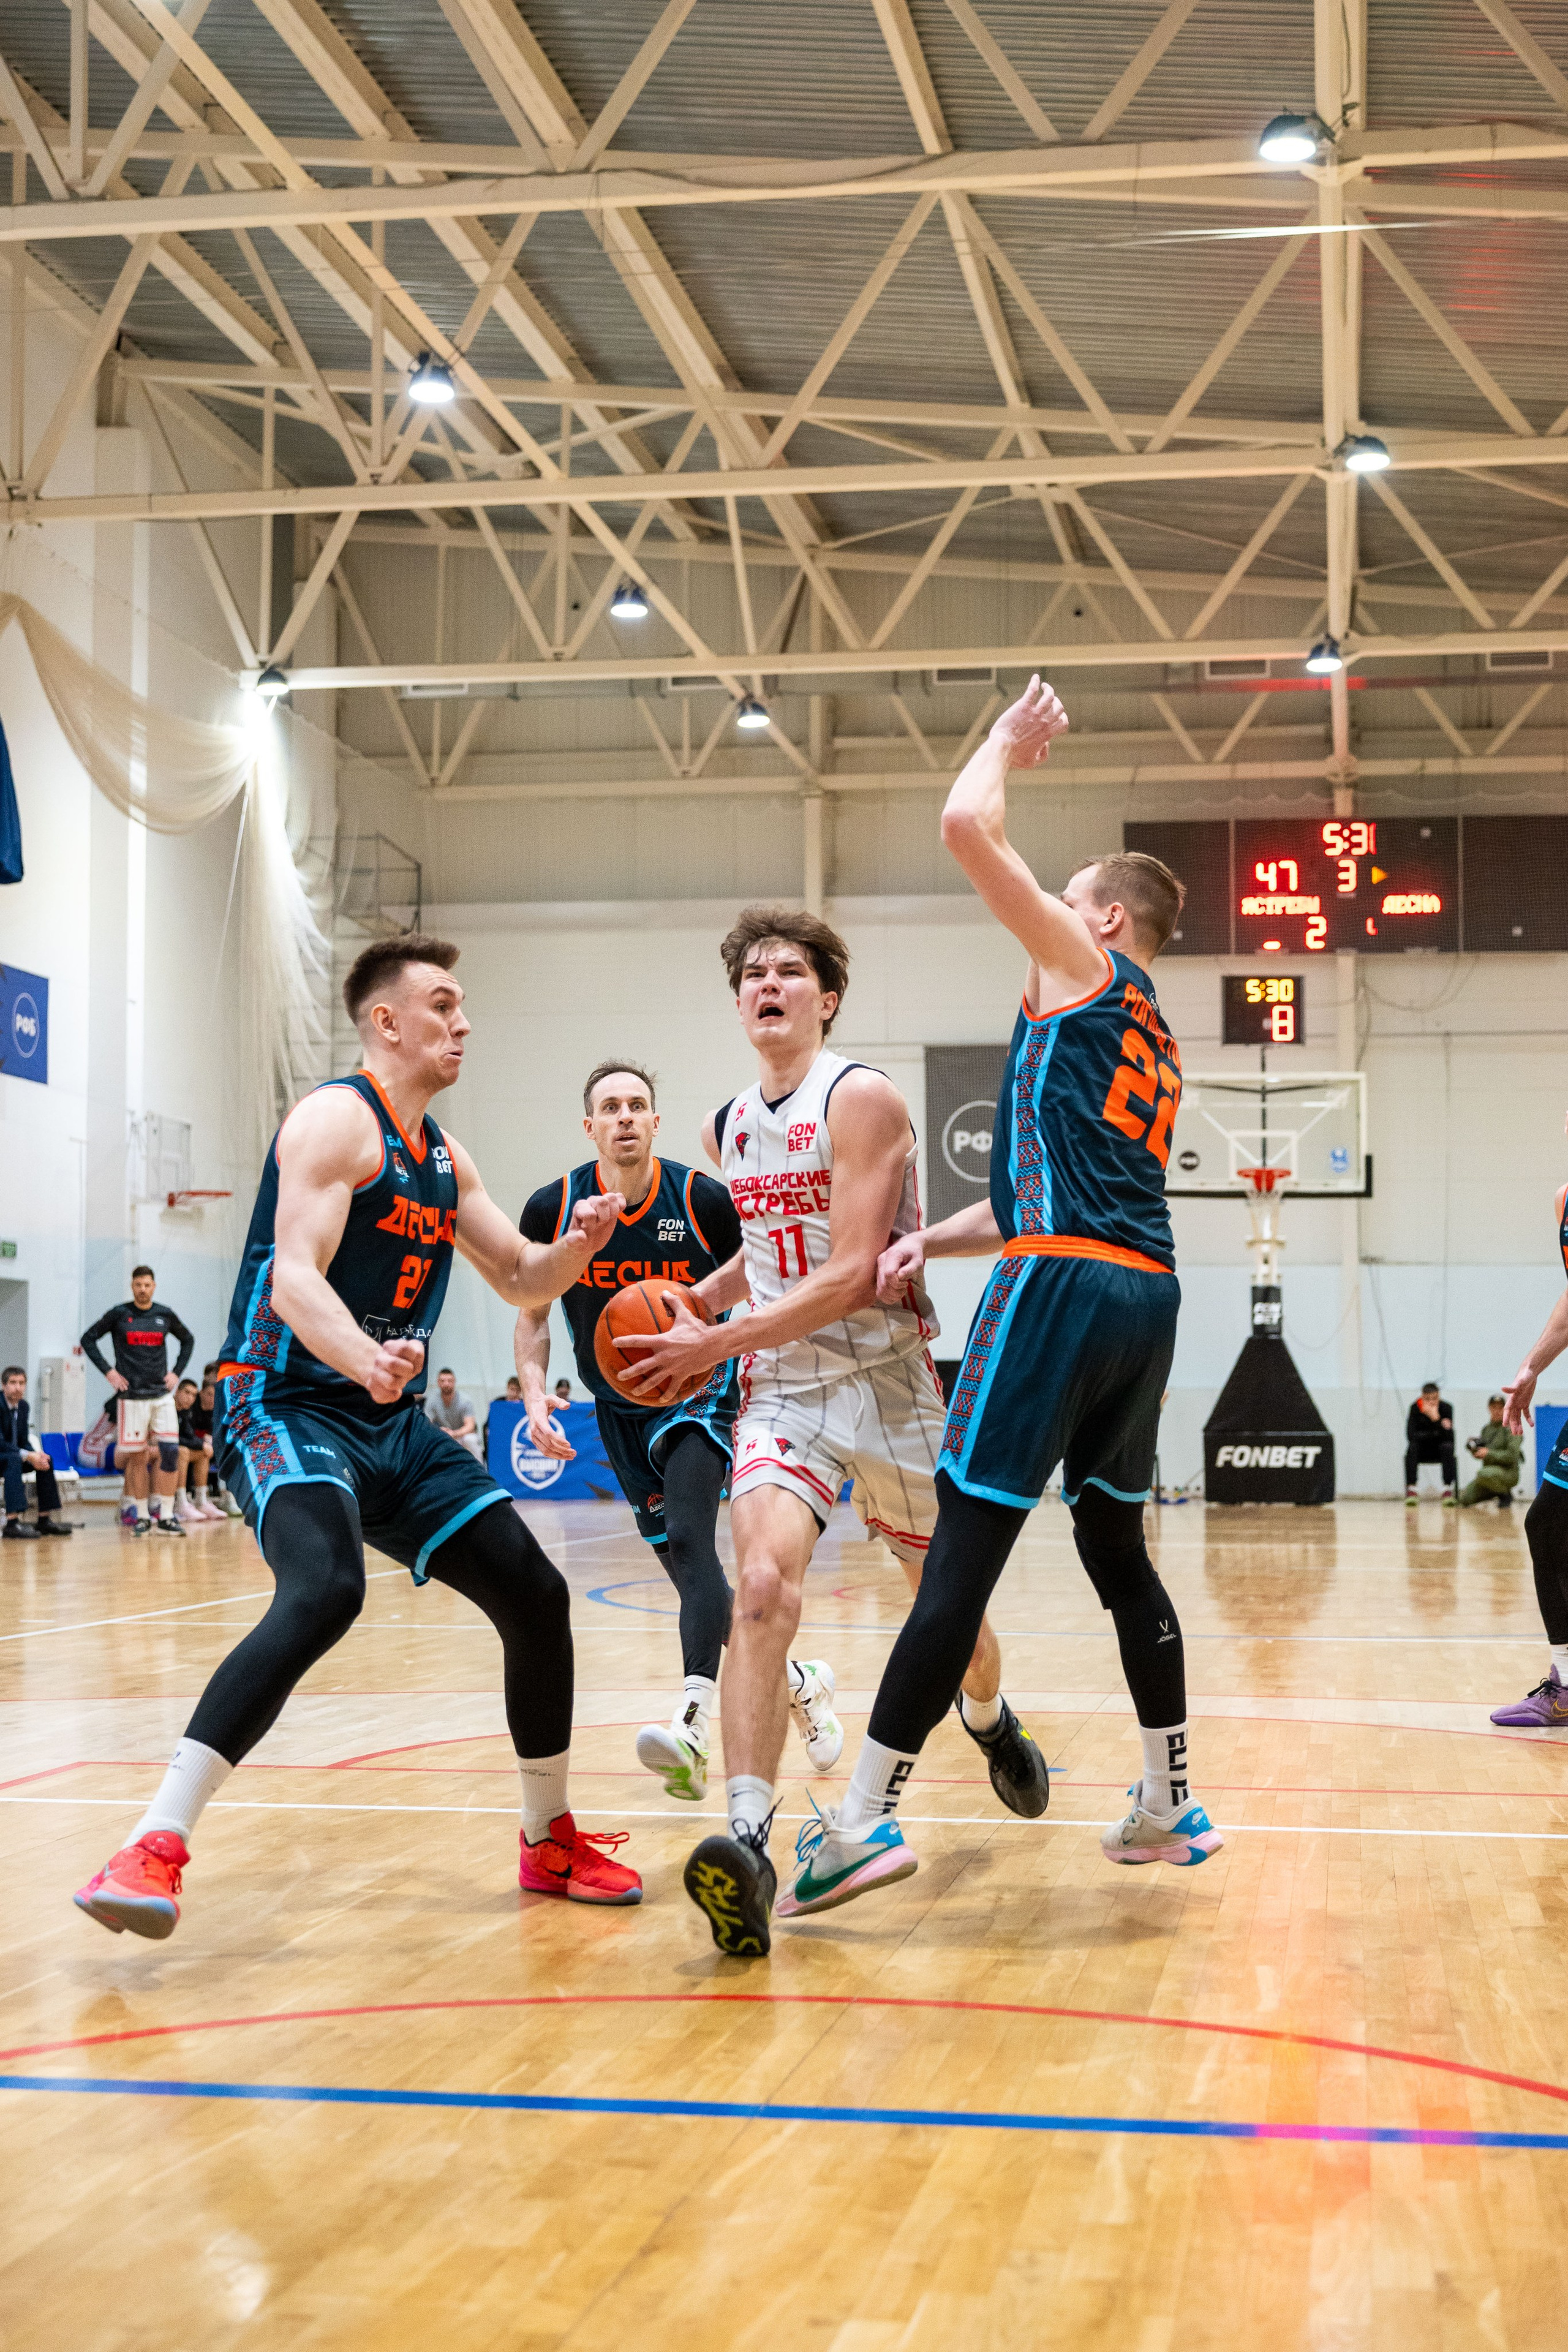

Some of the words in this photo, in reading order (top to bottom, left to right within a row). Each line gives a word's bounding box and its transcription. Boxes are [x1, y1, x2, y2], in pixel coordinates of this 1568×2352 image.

[1255, 859, 1298, 891] 47
[1337, 859, 1357, 892] 3
[1305, 915, 1328, 950] 2
[1245, 978, 1294, 1003] 5:30
[1271, 1005, 1295, 1042] 8
[787, 1122, 816, 1137] FON
[952, 1129, 993, 1153] РФ
[788, 1137, 813, 1152] BET
[435, 1159, 453, 1174] BET
[657, 1219, 685, 1231] FON
[658, 1231, 686, 1242] BET
[768, 1223, 808, 1278] 11
[1215, 1445, 1322, 1469] FONBET
